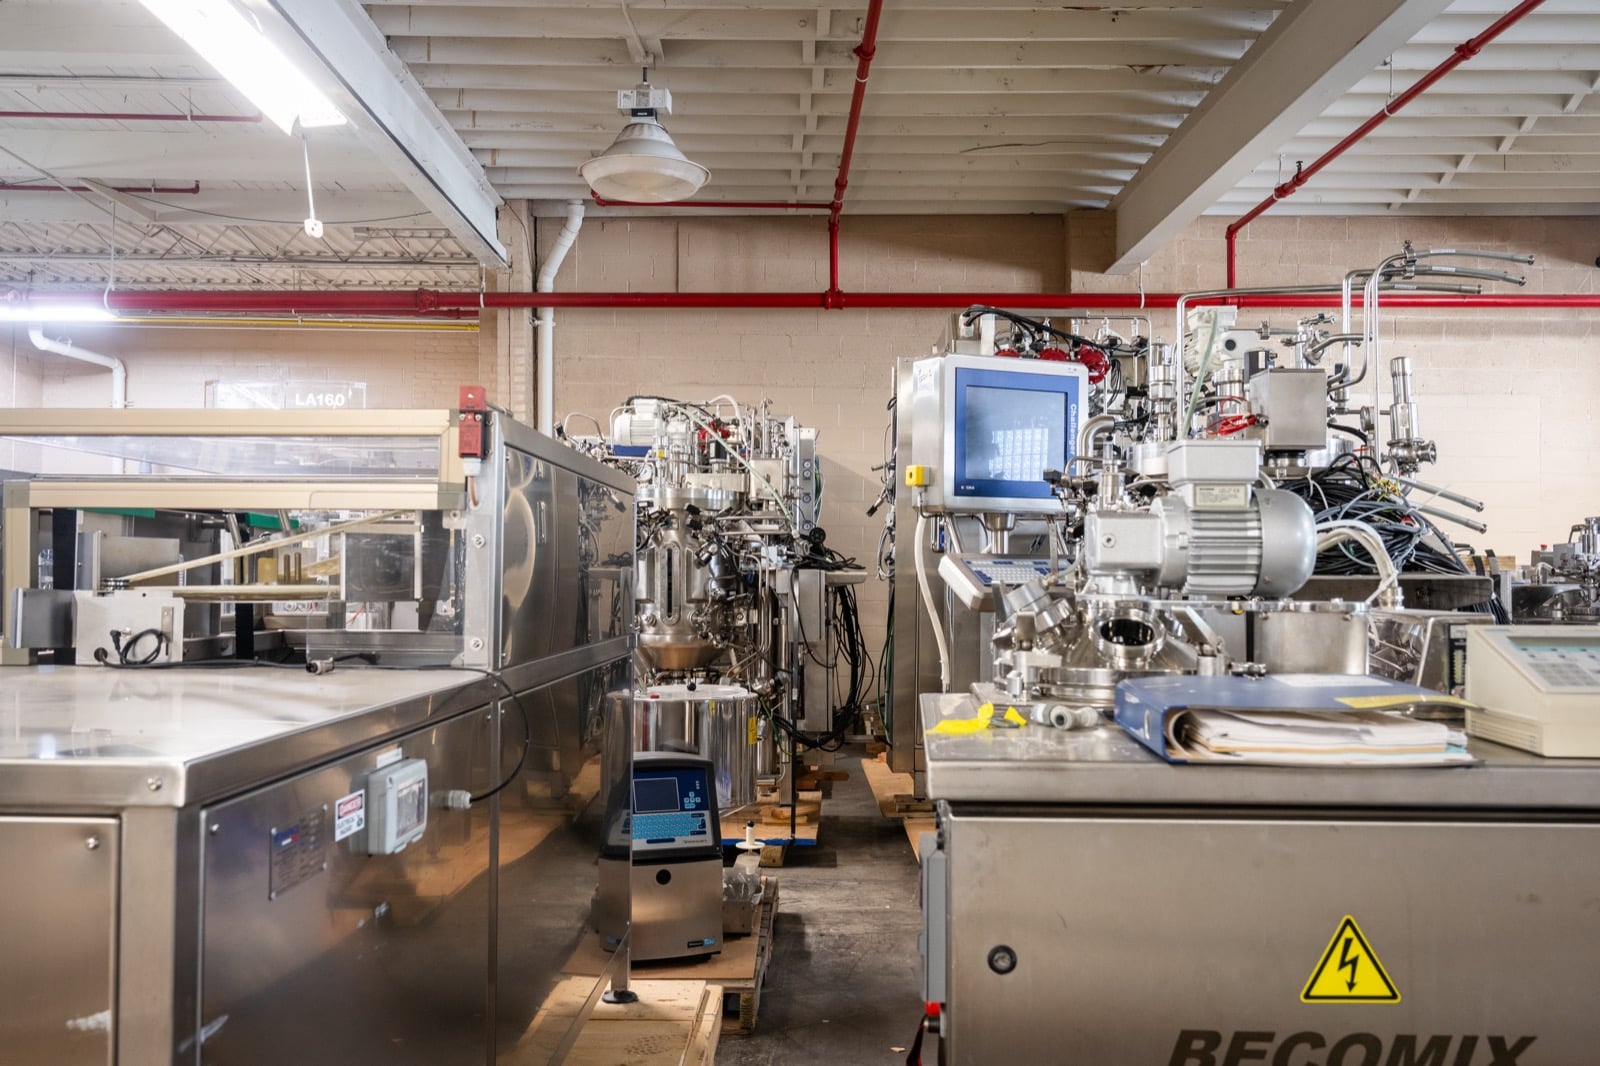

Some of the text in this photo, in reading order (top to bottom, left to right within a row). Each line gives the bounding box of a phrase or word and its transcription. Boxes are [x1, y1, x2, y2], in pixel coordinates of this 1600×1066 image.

[295, 393, 345, 407] LA160
[1068, 403, 1077, 456] Challenger
[1168, 1029, 1538, 1066] BECOMIX
